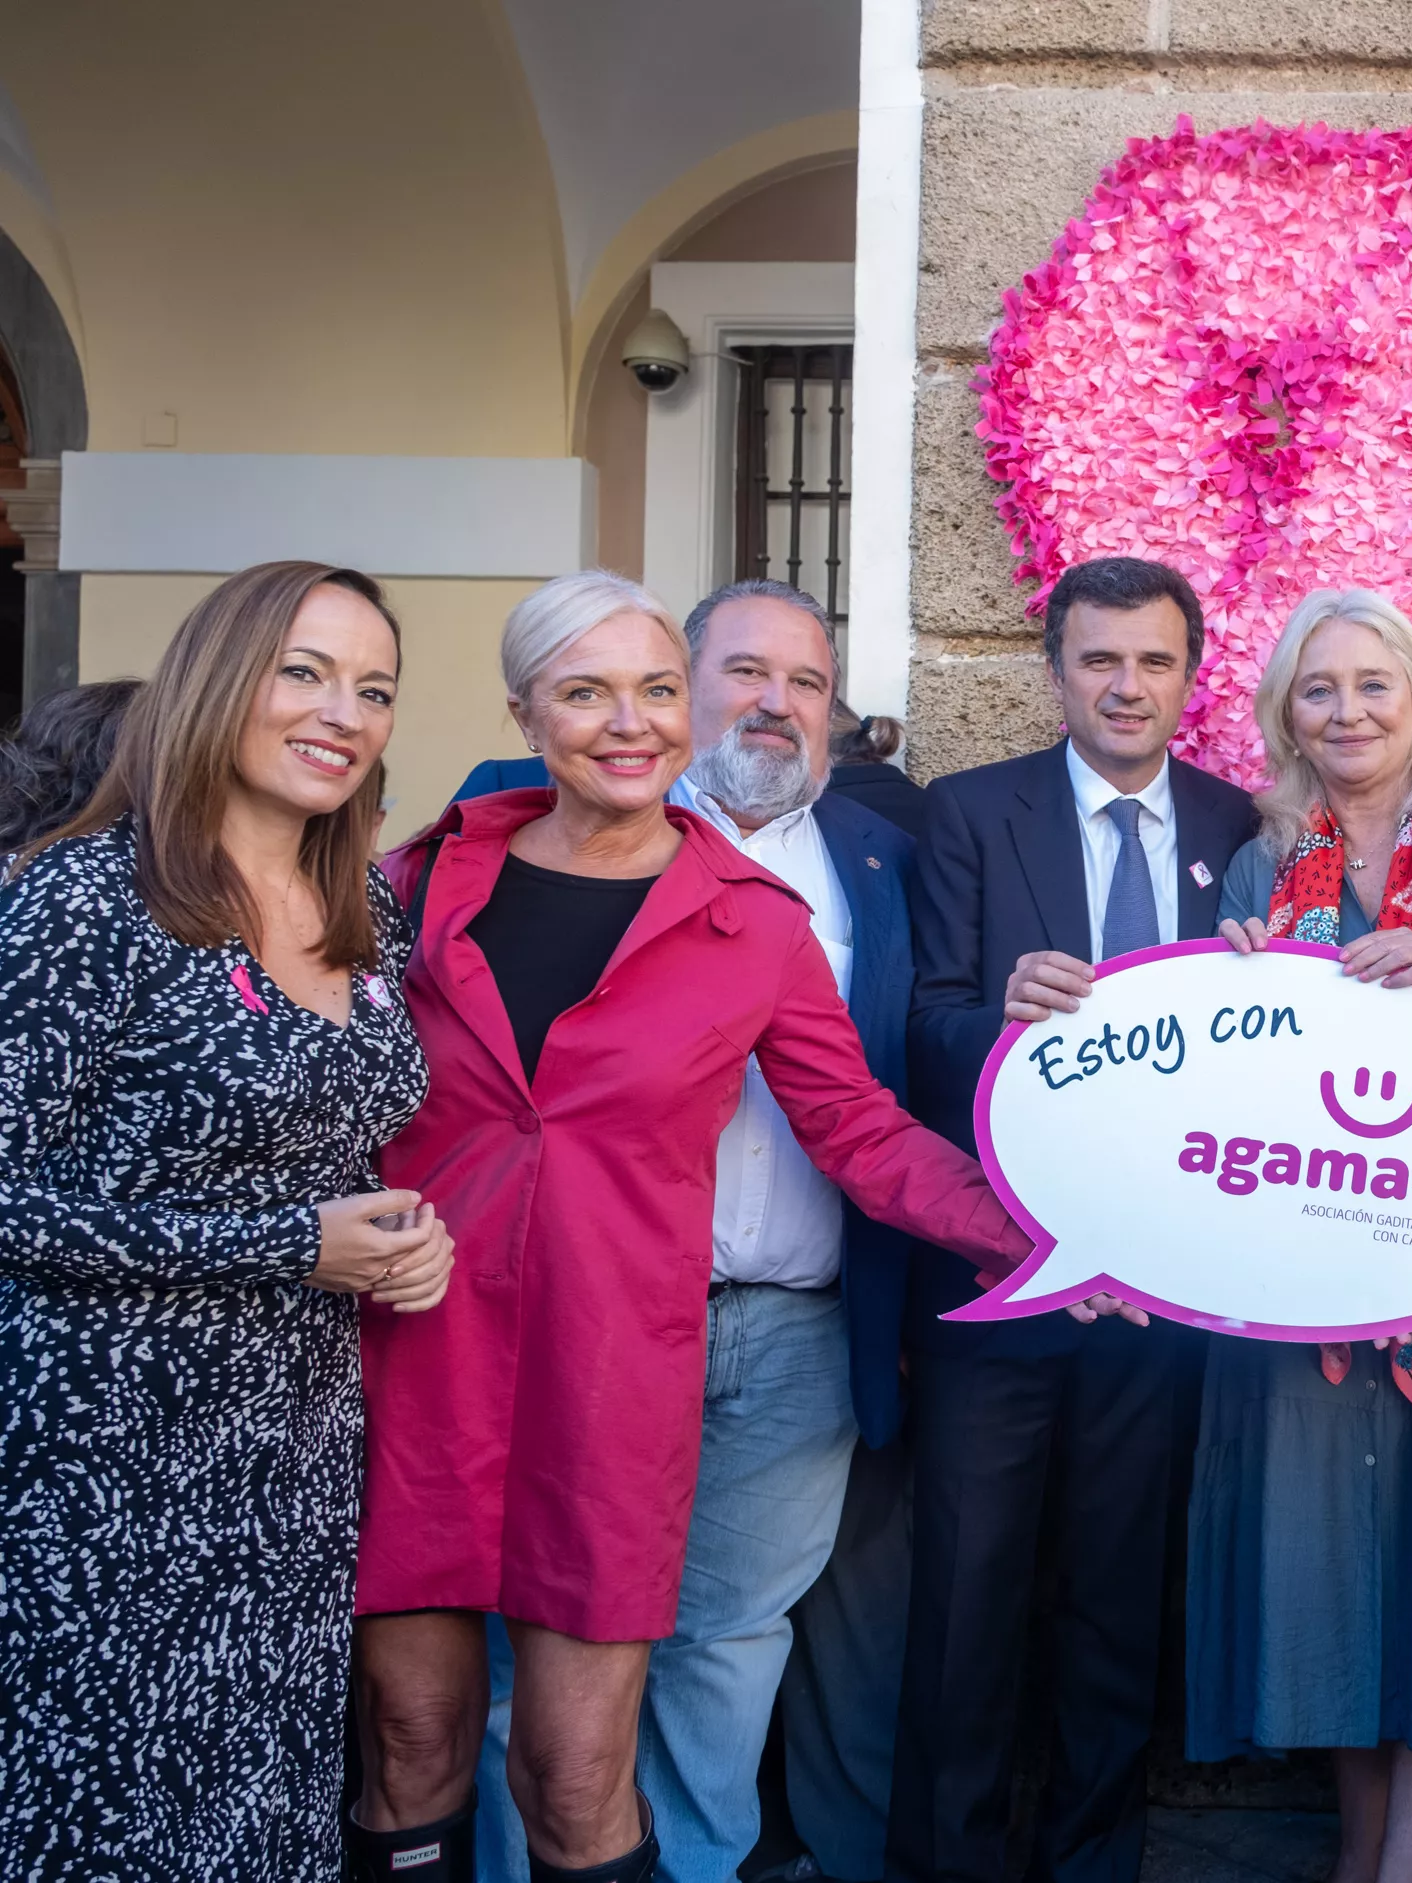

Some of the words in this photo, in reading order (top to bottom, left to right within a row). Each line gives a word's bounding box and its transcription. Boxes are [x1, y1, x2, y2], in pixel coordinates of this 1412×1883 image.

[1028, 1013, 1185, 1091] Estoy
[1210, 1004, 1304, 1043] con
[1301, 1203, 1373, 1224] ASOCIACIÓN
[1373, 1229, 1398, 1244] CON
[394, 1848, 437, 1863] HUNTER
